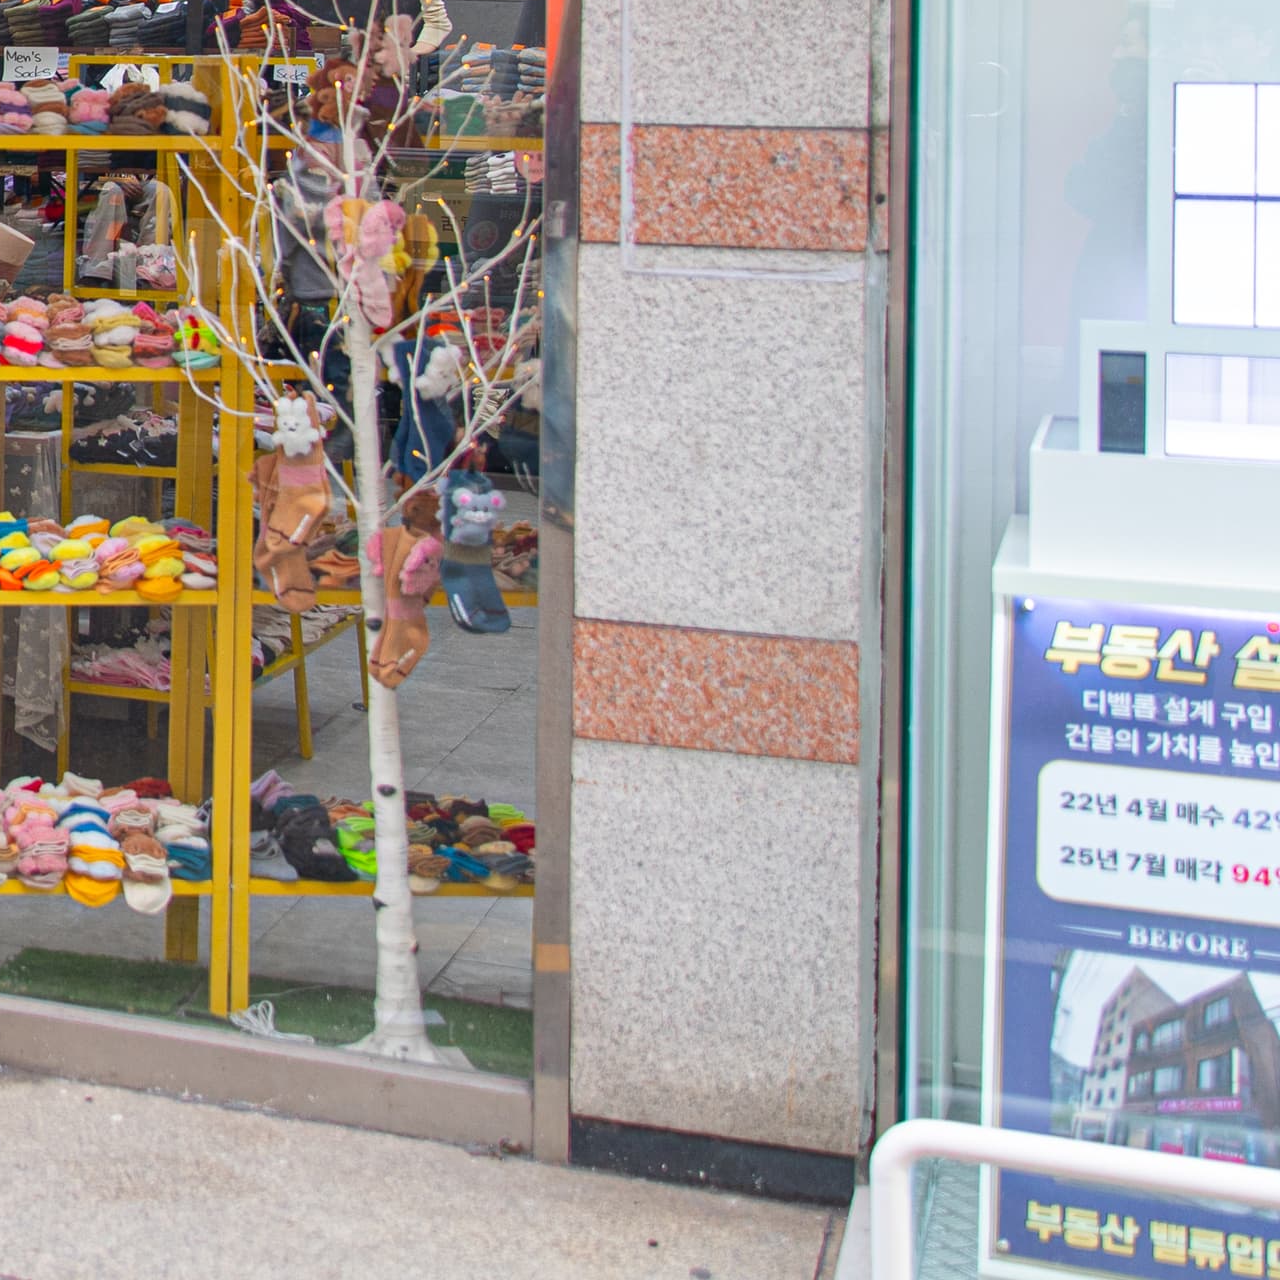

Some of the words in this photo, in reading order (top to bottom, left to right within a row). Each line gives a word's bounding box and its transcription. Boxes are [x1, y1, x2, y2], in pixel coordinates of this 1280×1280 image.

[6, 49, 42, 63] Men's
[14, 65, 52, 78] Socks
[1043, 620, 1221, 685] 부동산
[1164, 695, 1216, 728] 설계
[1221, 701, 1274, 733] 구입
[1065, 722, 1140, 757] 건물의
[1145, 731, 1223, 766] 가치를
[1060, 790, 1118, 817] 22년
[1125, 798, 1168, 823] 4월
[1175, 801, 1225, 828] 매수
[1059, 844, 1119, 872] 25년
[1125, 852, 1167, 879] 7월
[1173, 856, 1224, 885] 매각
[1126, 923, 1251, 962] BEFORE
[1025, 1198, 1141, 1257] 부동산
